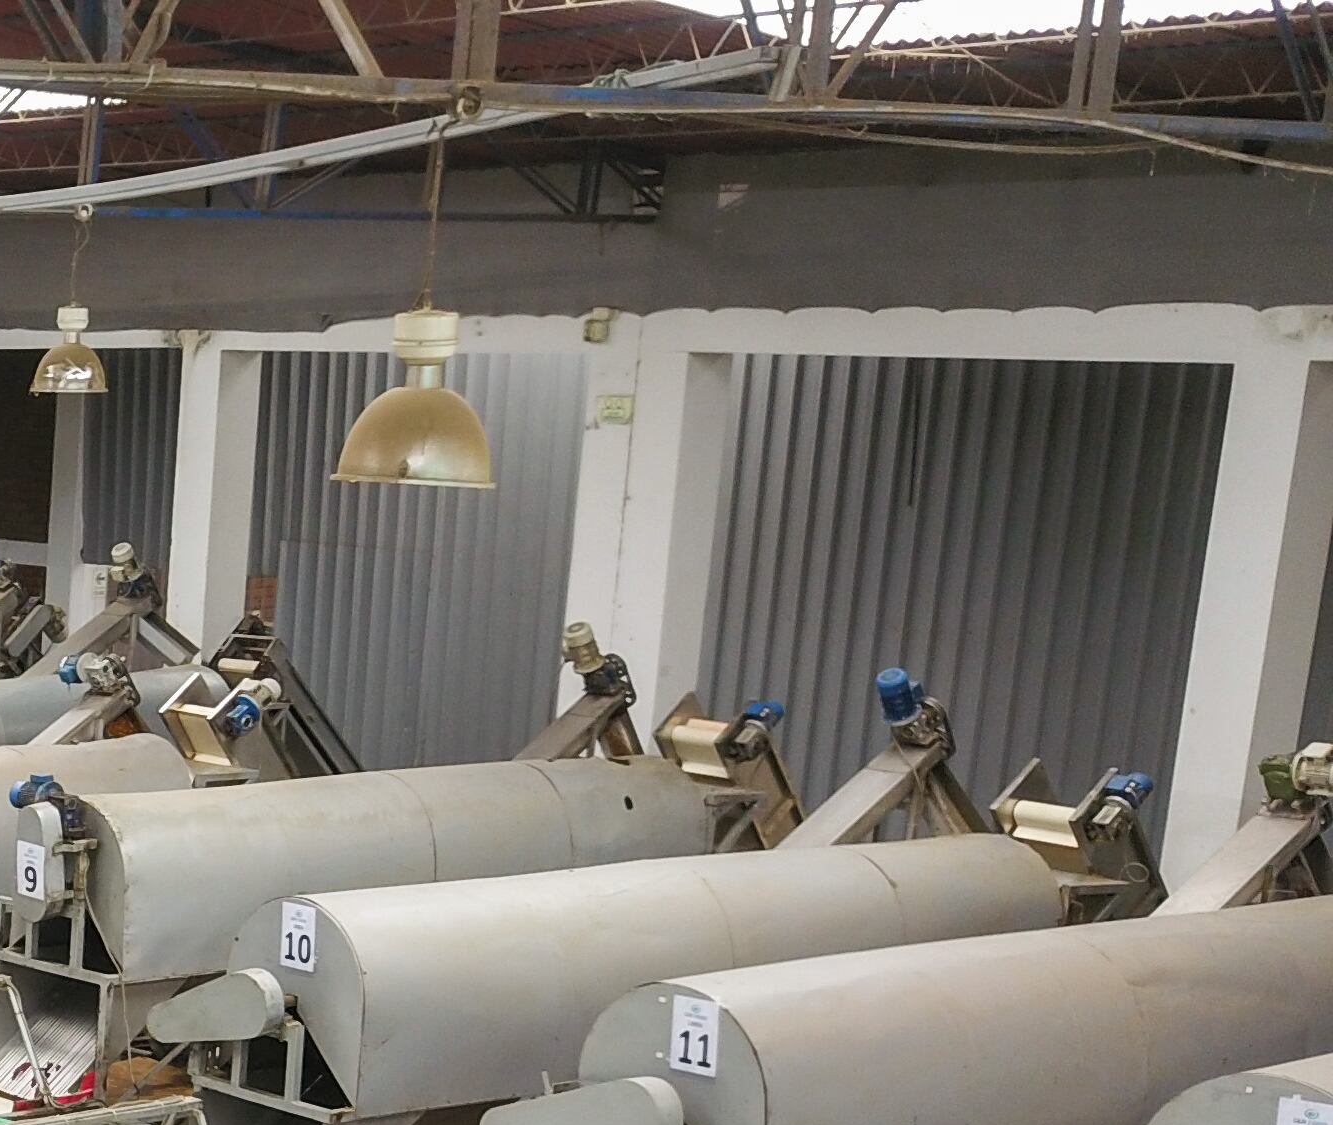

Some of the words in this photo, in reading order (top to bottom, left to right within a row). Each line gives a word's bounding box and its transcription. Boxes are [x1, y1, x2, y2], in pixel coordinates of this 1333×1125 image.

[25, 866, 37, 892] 9
[285, 932, 311, 963] 10
[678, 1031, 711, 1068] 11
